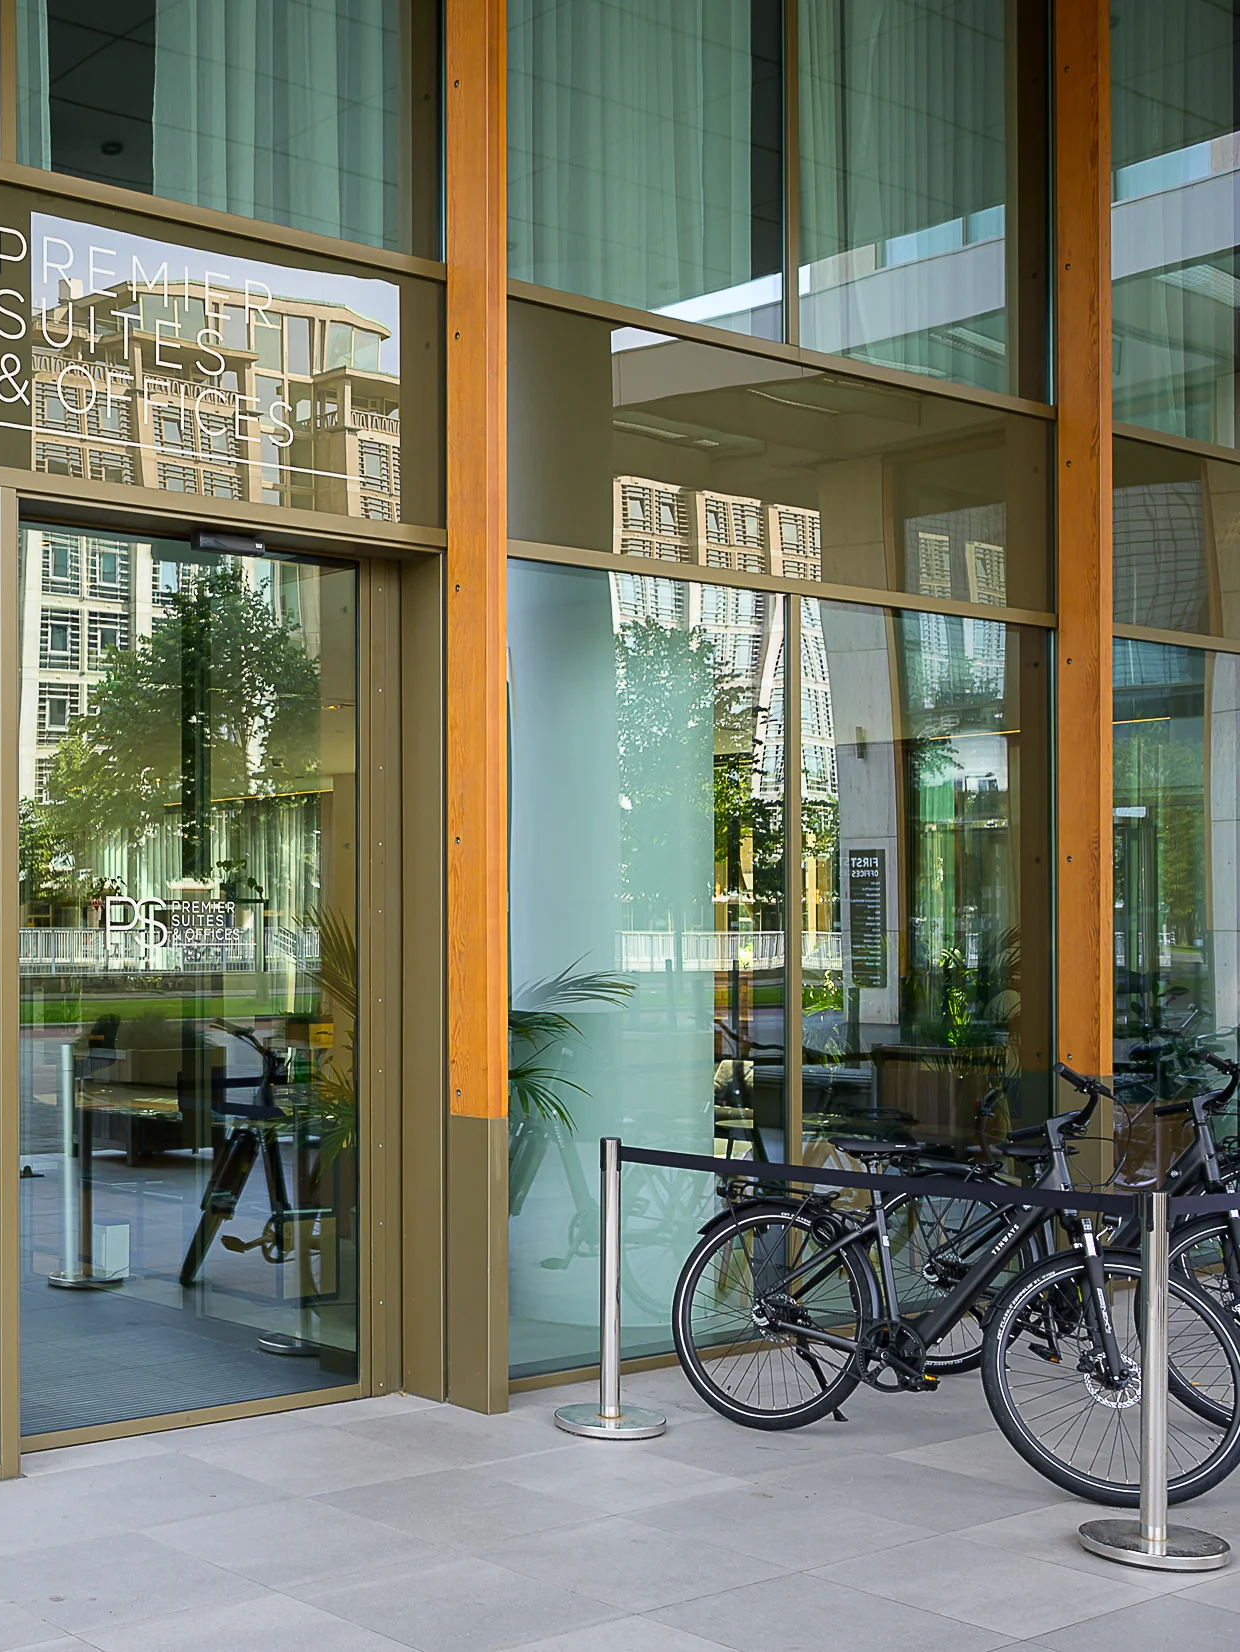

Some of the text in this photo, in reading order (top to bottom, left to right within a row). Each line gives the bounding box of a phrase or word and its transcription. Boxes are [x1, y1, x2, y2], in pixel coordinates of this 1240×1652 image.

[56, 365, 294, 448] OFFICES
[172, 901, 235, 913] PREMIER
[106, 896, 167, 950] PS
[172, 914, 223, 926] SUITES
[172, 929, 240, 941] & OFFICES
